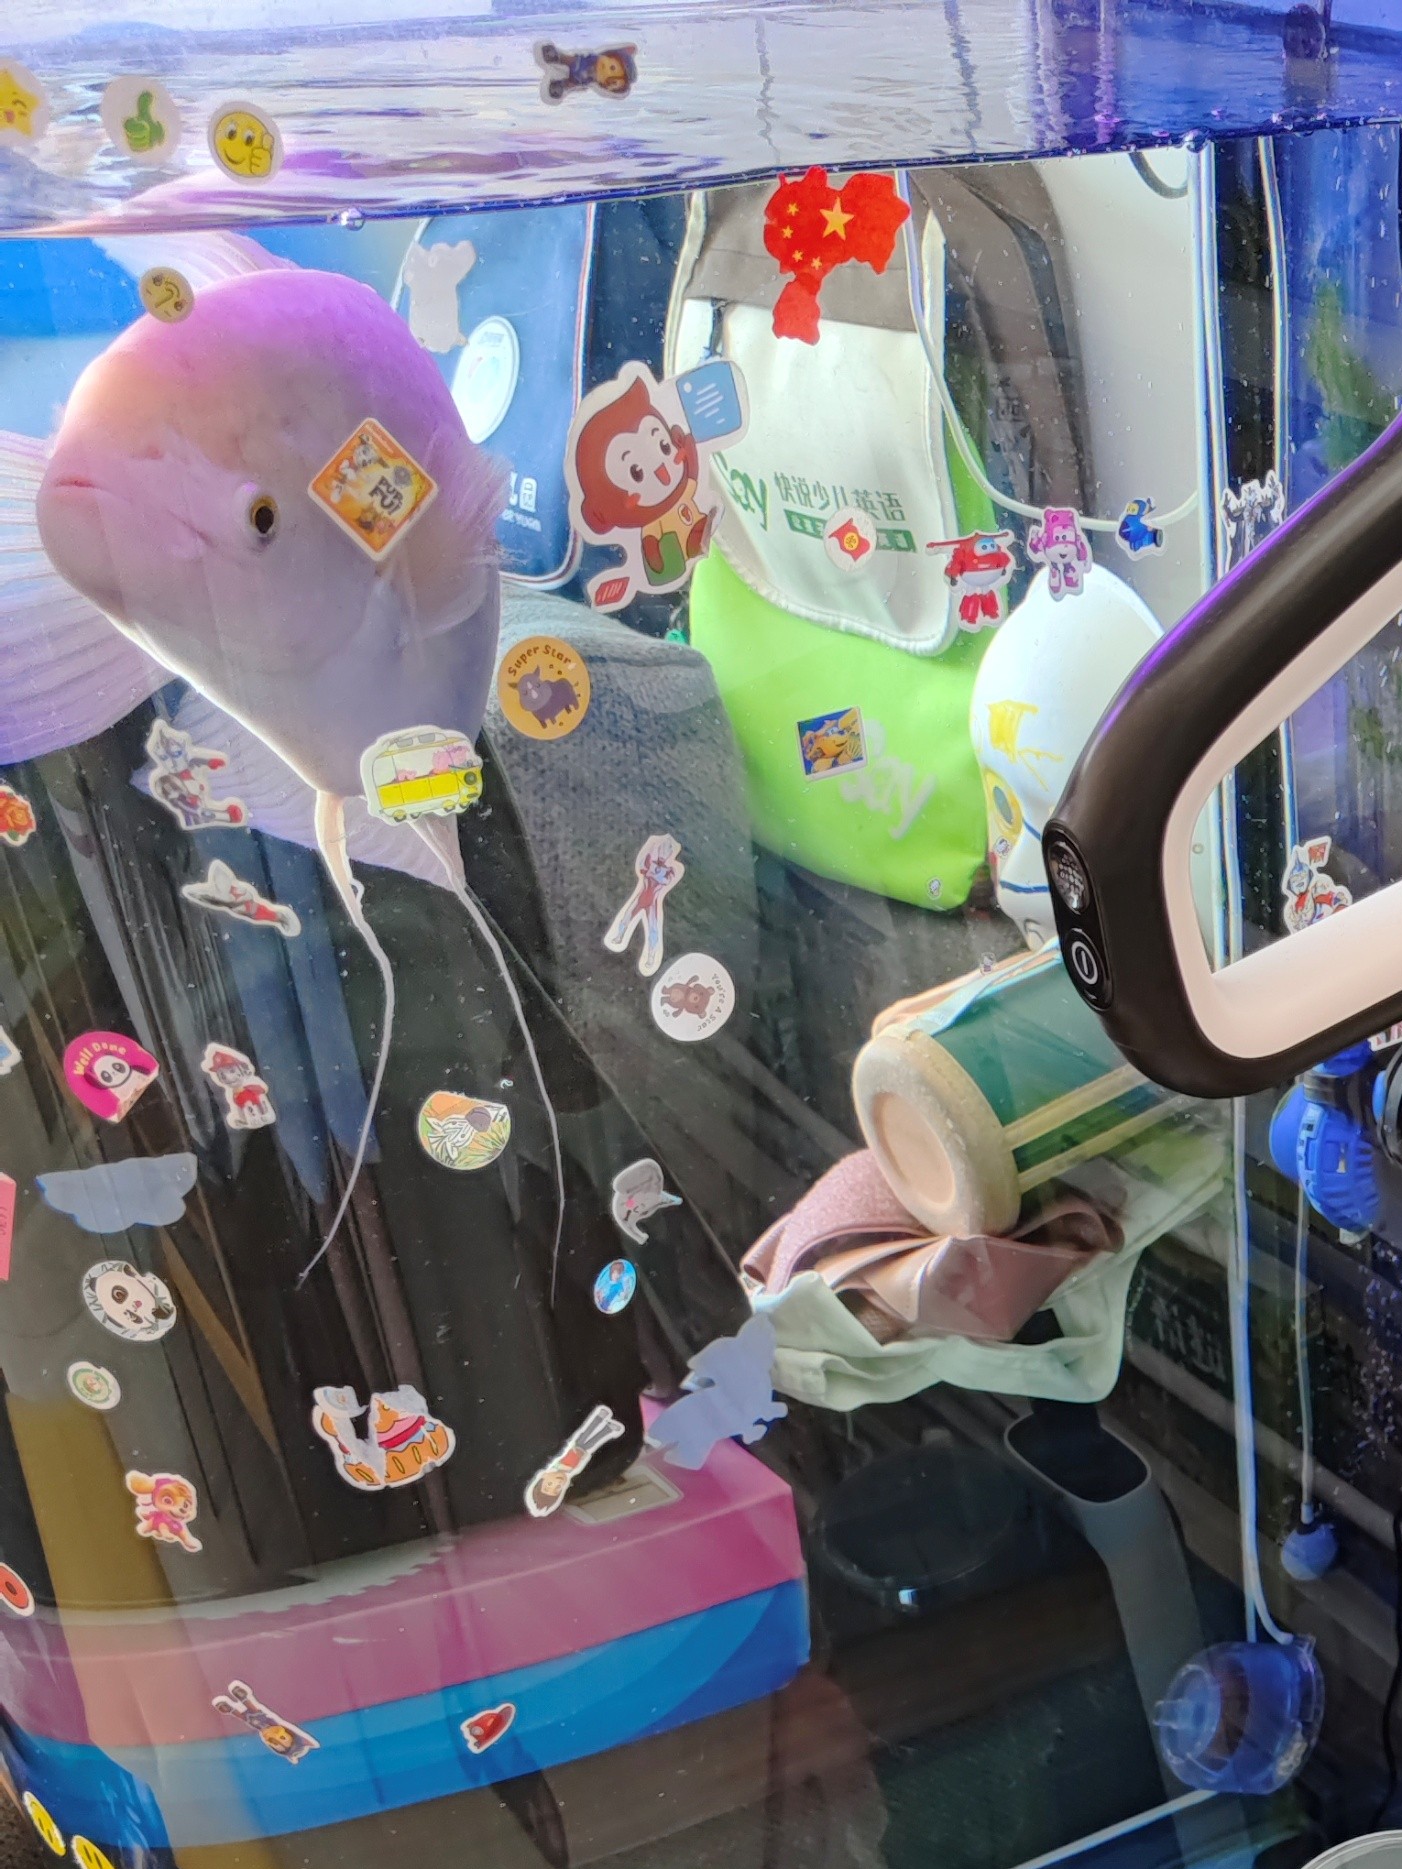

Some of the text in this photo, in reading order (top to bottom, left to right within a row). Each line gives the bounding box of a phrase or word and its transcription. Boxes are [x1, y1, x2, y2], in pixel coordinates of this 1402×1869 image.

[508, 643, 573, 678] Super Star
[73, 1040, 128, 1076] Well Done
